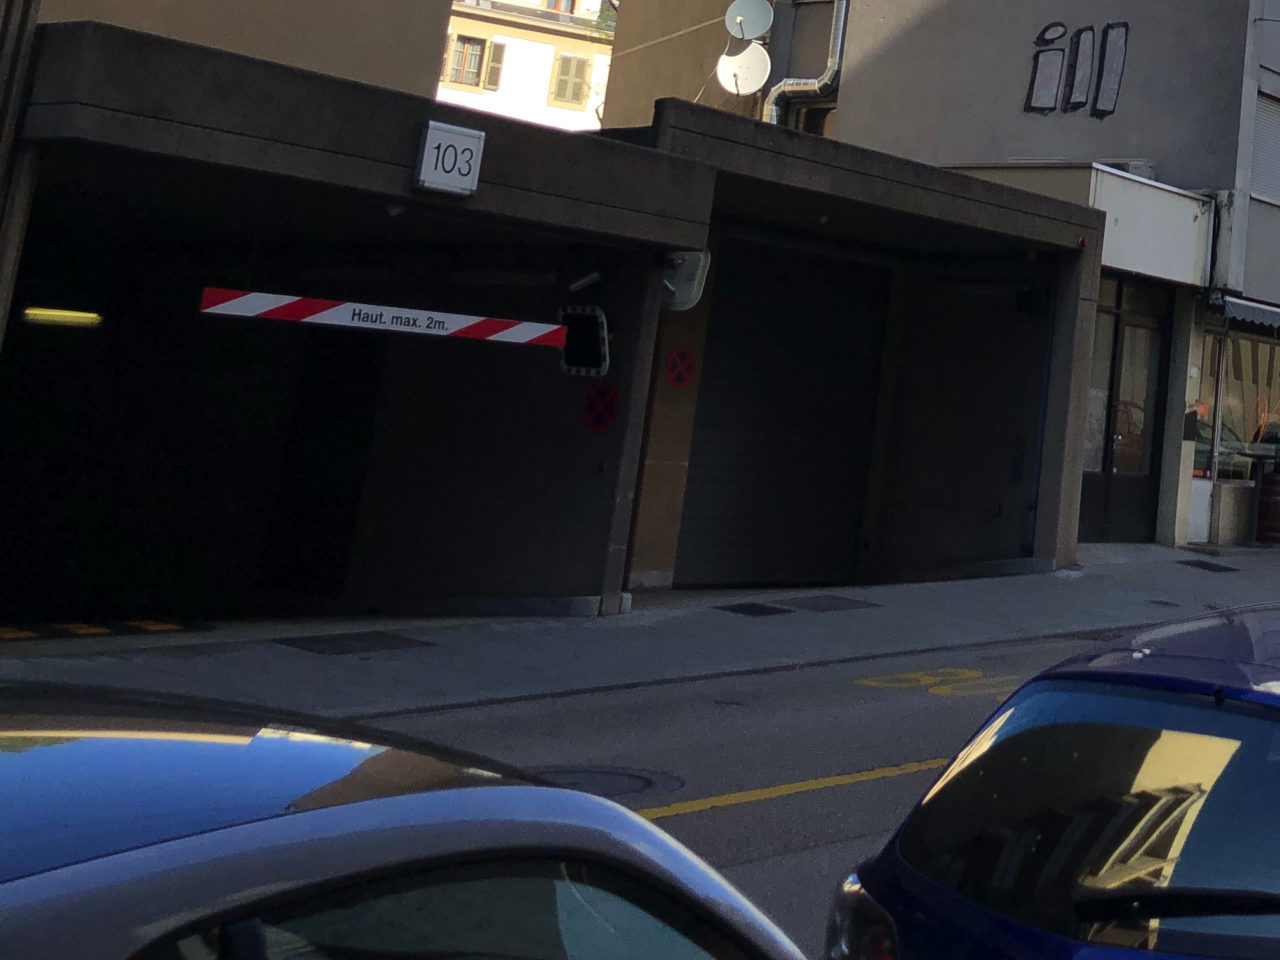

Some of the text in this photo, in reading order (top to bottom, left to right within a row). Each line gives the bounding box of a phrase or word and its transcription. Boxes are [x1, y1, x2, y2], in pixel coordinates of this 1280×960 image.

[432, 142, 474, 177] 103
[351, 308, 448, 331] Haut. max. 2m.
